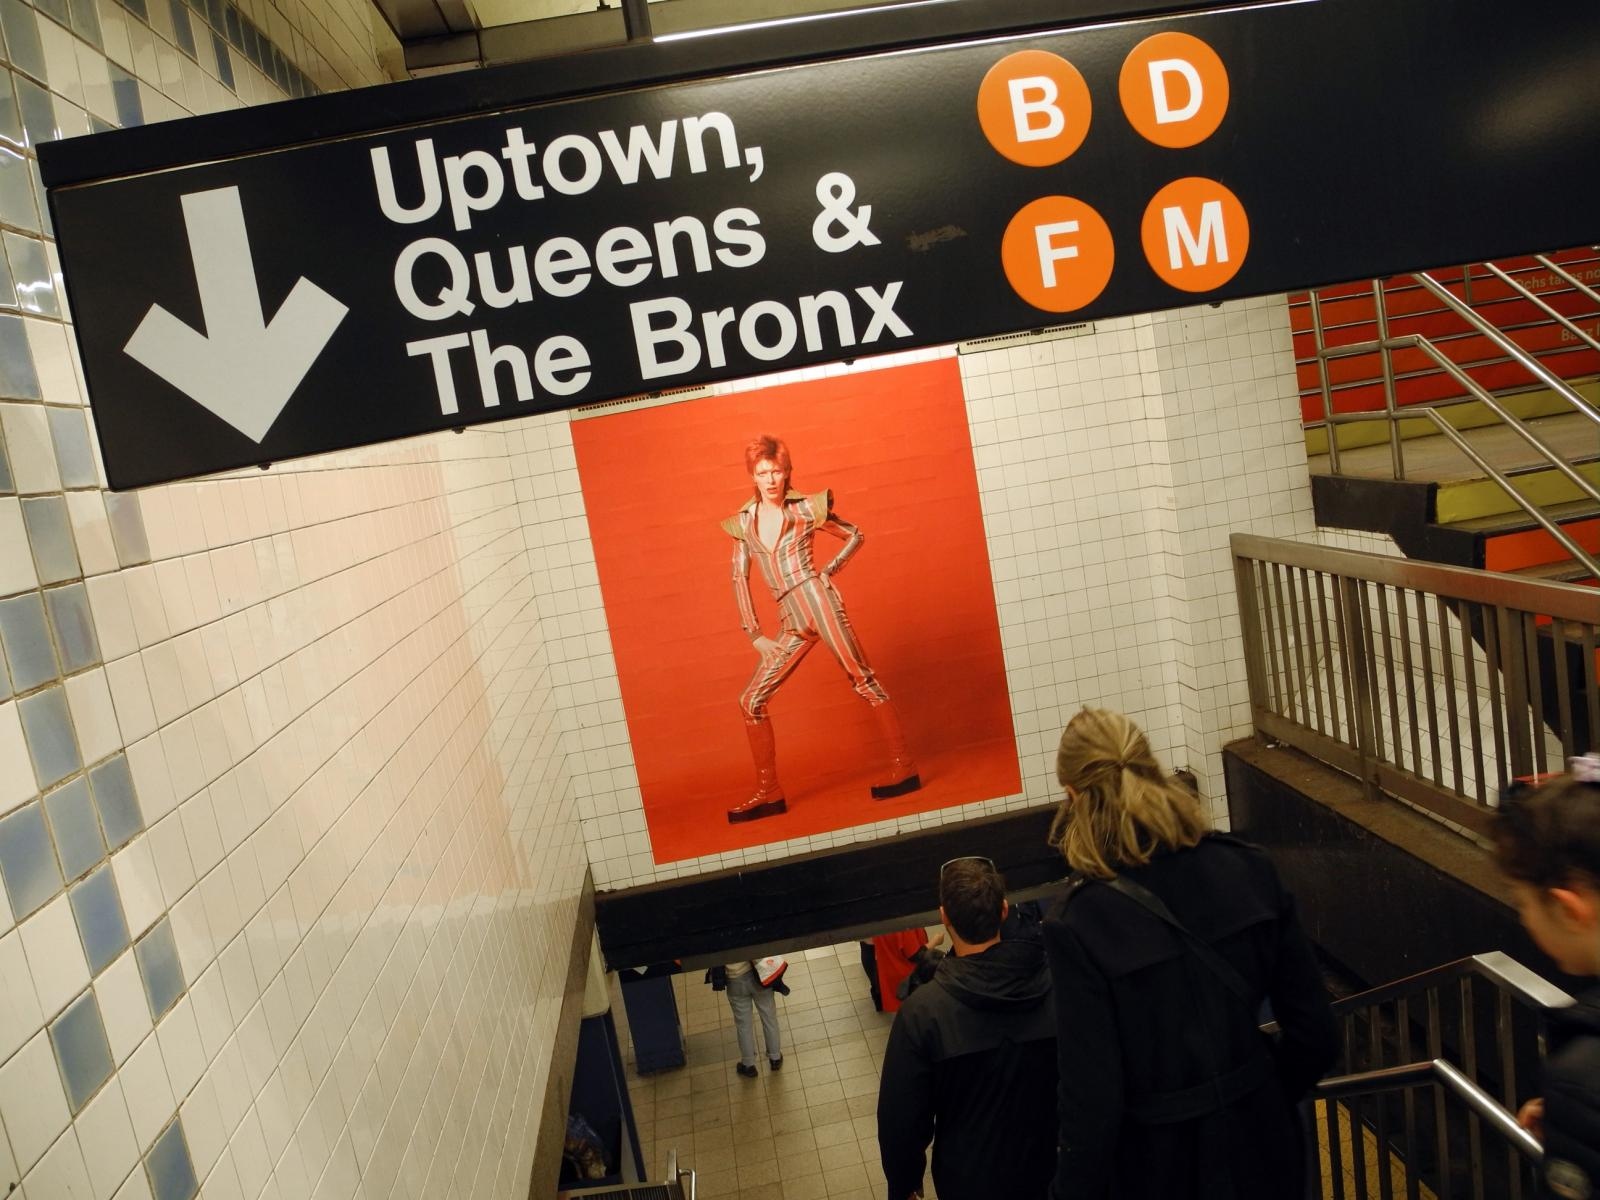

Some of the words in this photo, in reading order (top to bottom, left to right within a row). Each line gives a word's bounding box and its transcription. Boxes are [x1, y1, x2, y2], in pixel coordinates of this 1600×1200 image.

[1007, 75, 1065, 143] B
[1148, 58, 1203, 124] D
[371, 111, 764, 231] Uptown,
[394, 207, 767, 321] Queens
[812, 171, 882, 253] &
[1034, 220, 1079, 288] F
[1163, 200, 1229, 269] M
[406, 328, 592, 415] The
[629, 281, 914, 380] Bronx
